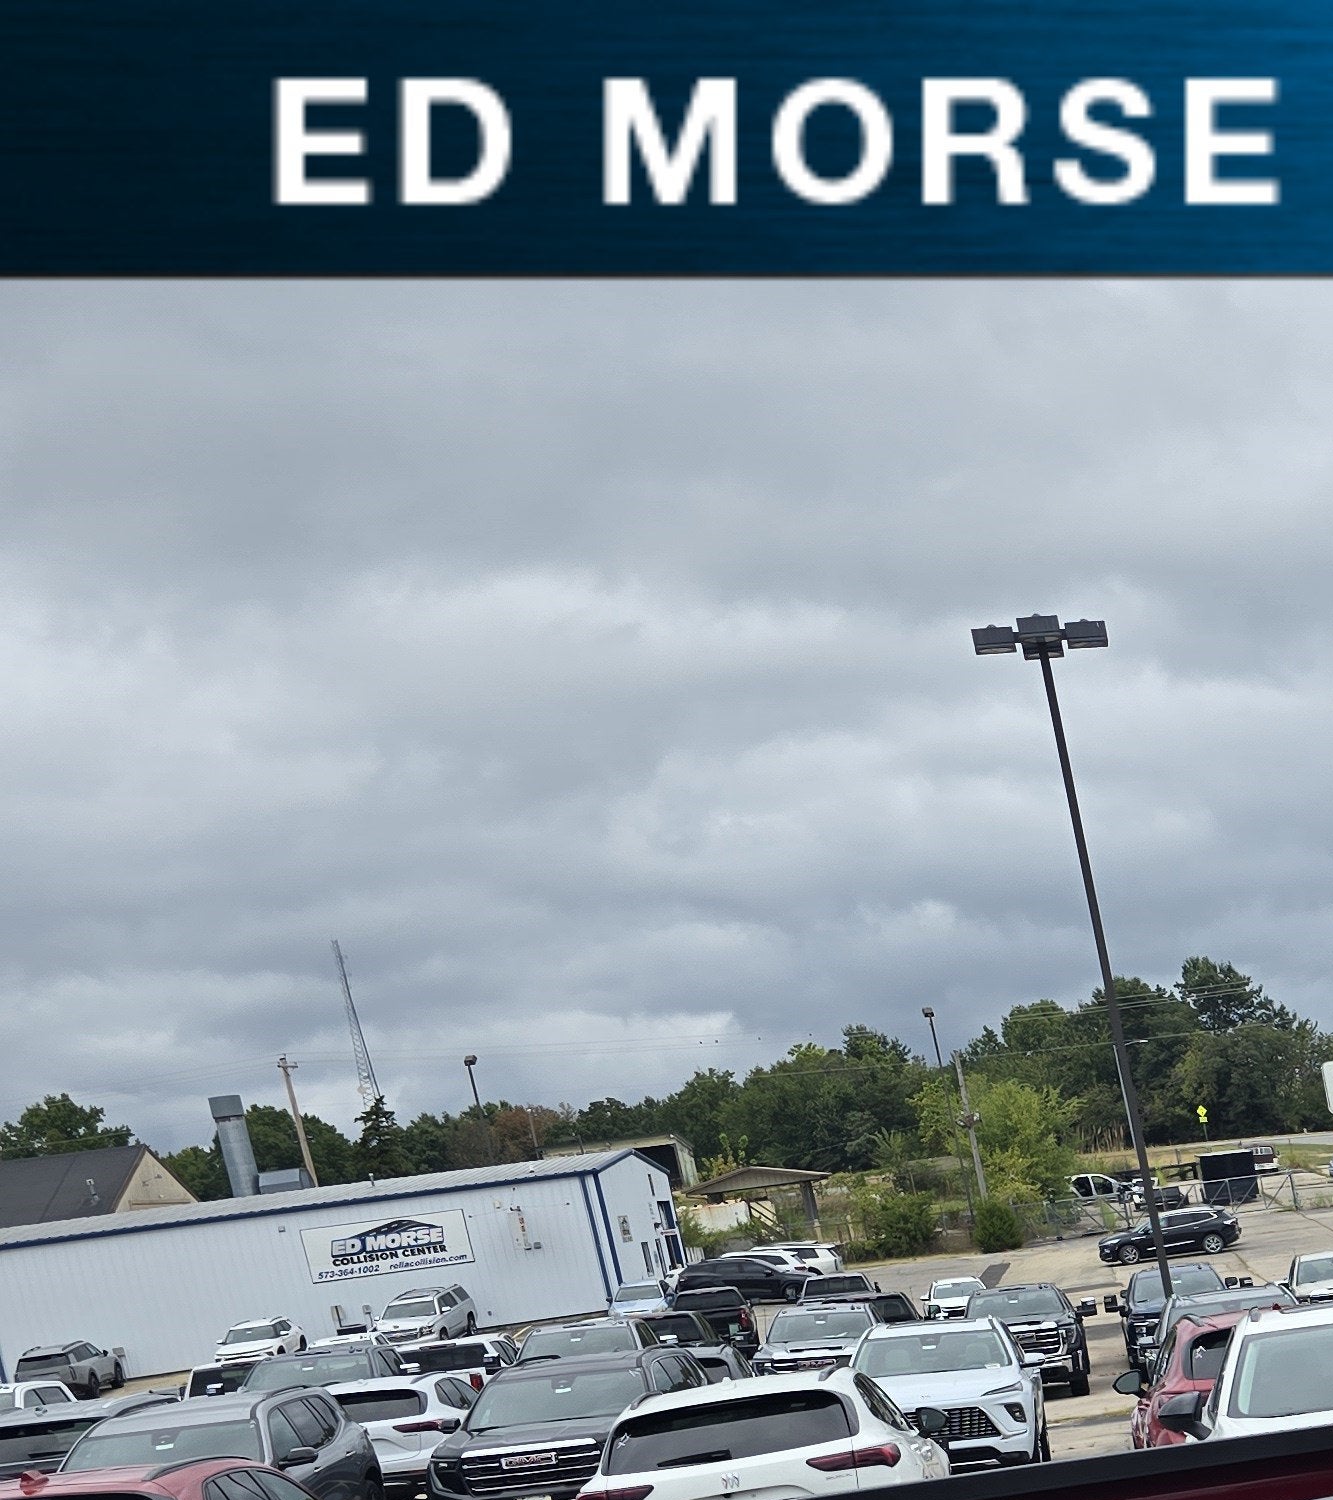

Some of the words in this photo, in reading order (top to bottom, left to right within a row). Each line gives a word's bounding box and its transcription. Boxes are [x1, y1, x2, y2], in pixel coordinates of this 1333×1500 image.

[332, 1239, 362, 1257] ED
[365, 1226, 444, 1253] MORSE
[318, 1264, 380, 1280] 573-364-1002
[389, 1253, 468, 1270] rollacollision.com
[332, 1250, 399, 1267] COLLISION
[402, 1244, 448, 1258] CENTER
